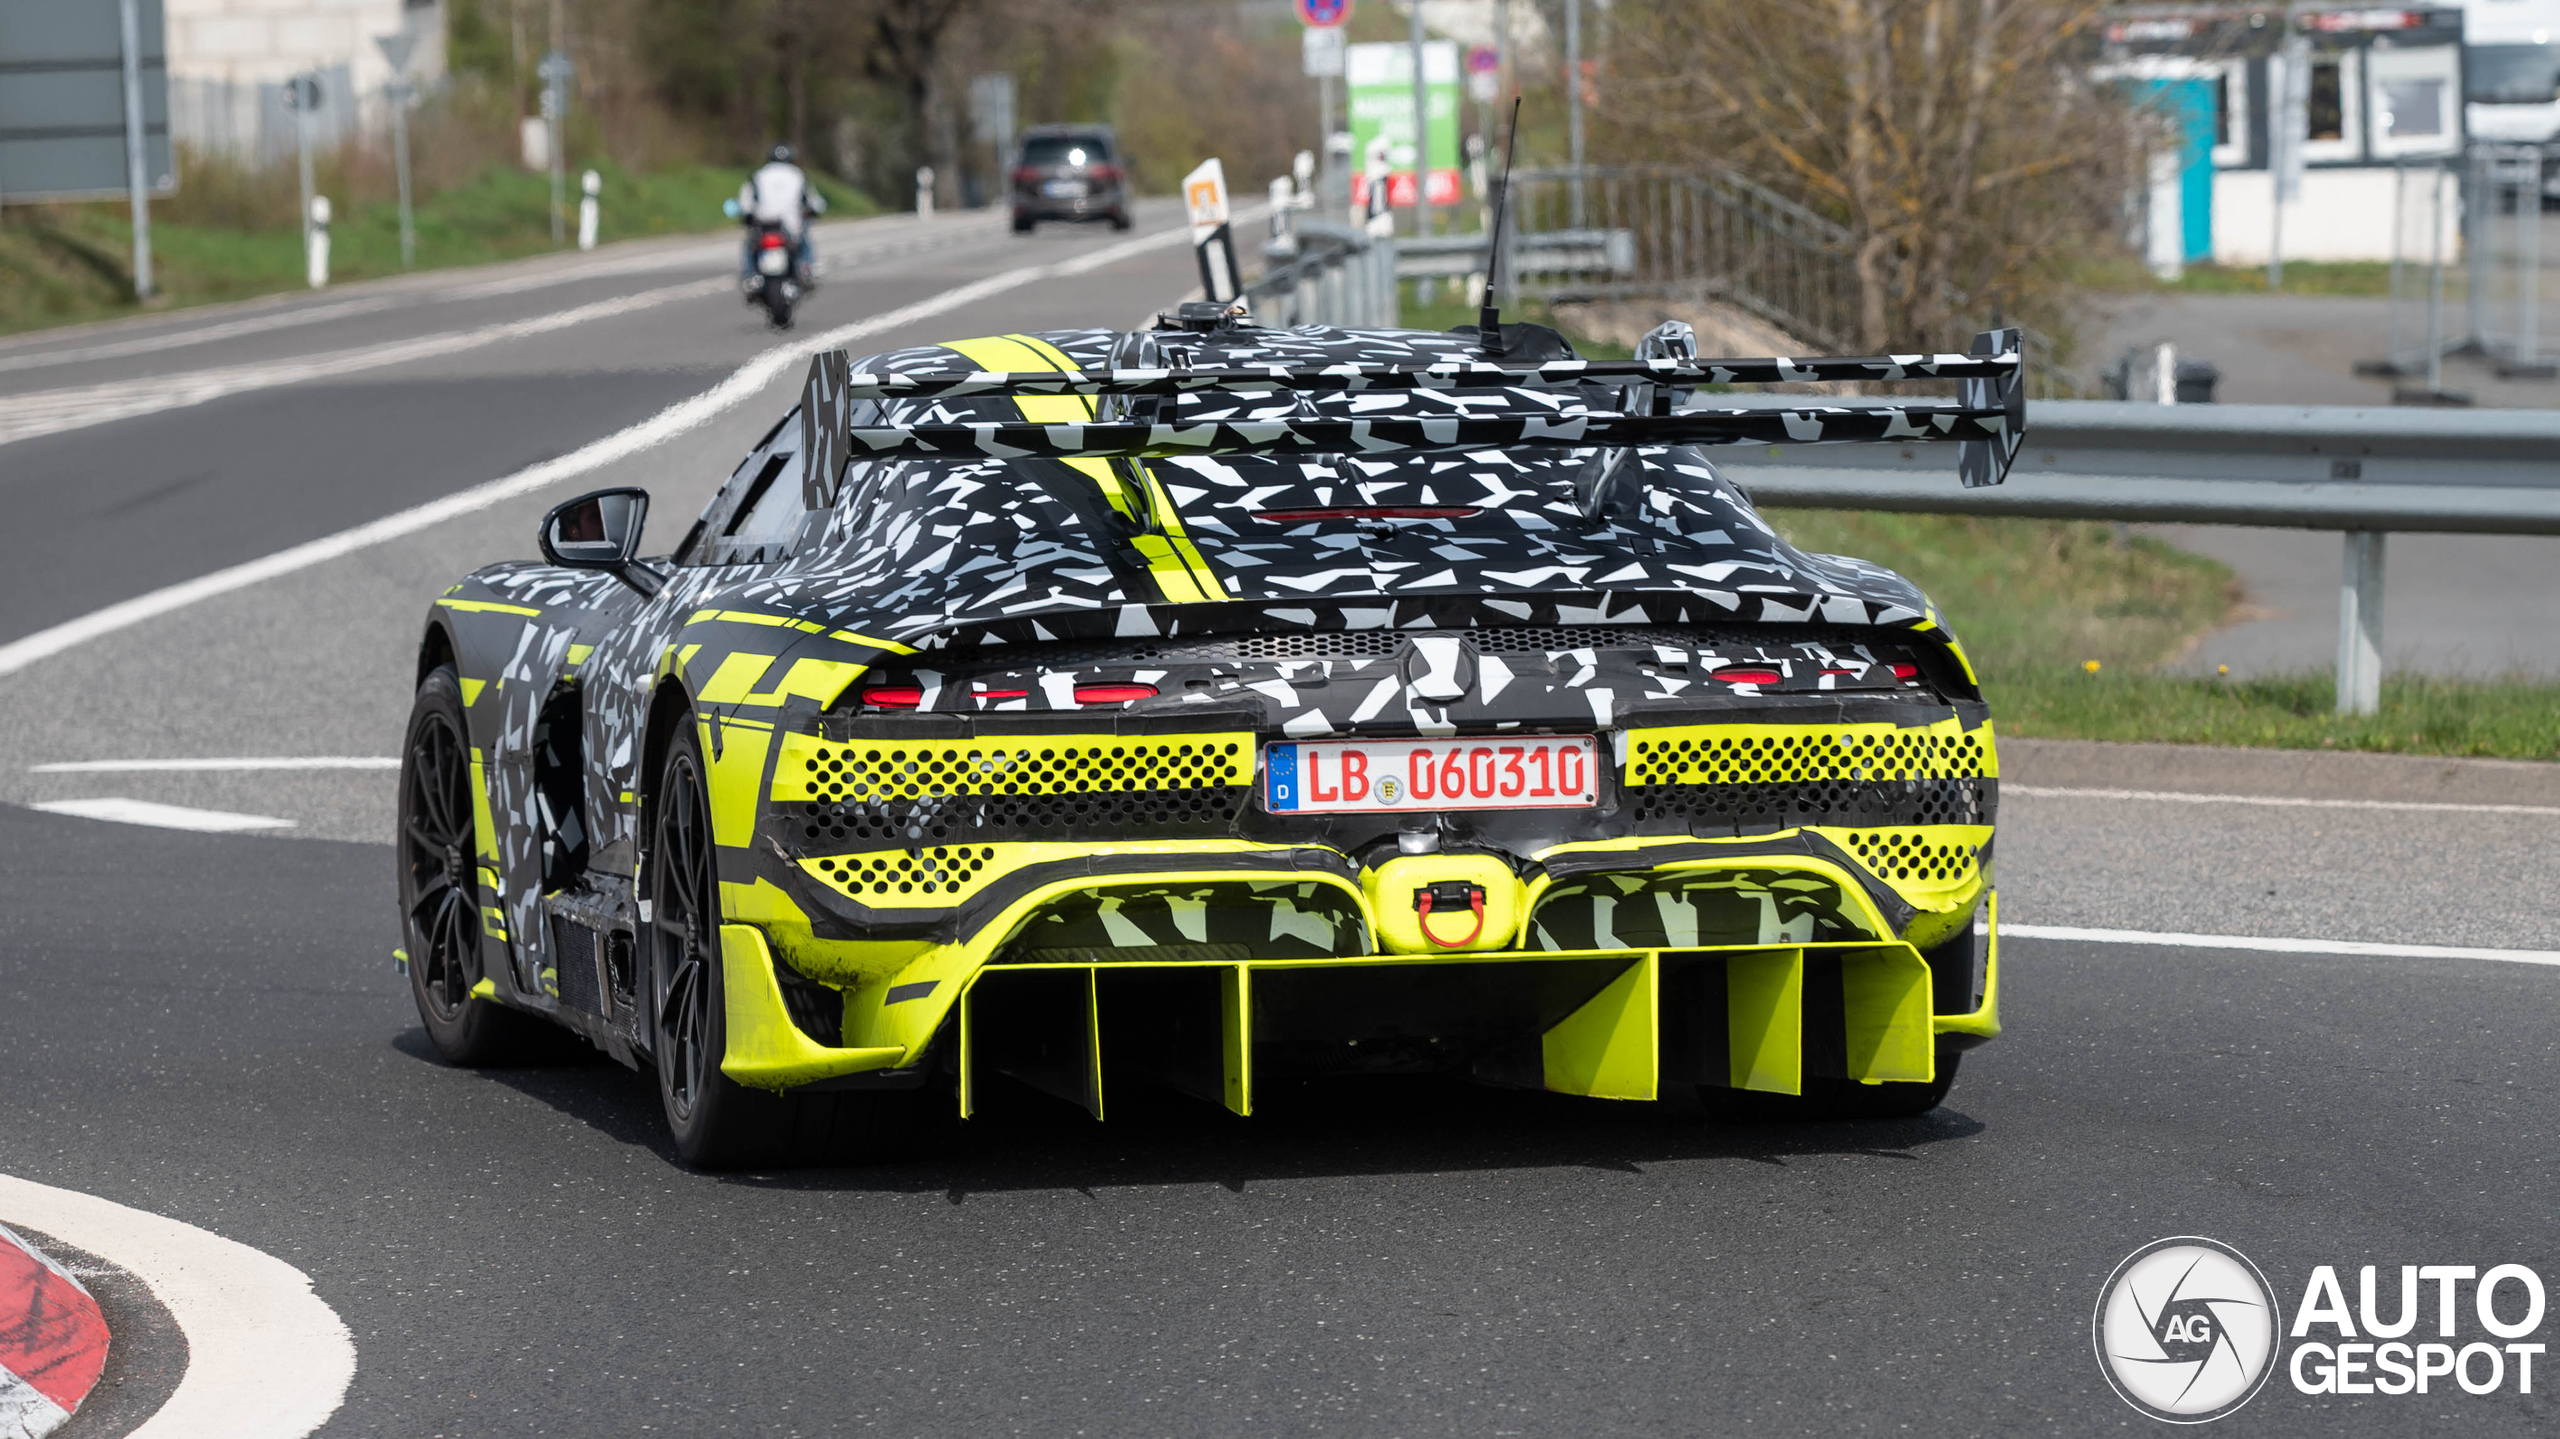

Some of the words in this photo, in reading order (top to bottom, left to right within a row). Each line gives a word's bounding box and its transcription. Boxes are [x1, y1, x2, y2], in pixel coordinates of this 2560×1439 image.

[1309, 750, 1369, 802] LB
[1409, 745, 1584, 800] 060310
[1277, 784, 1289, 800] D
